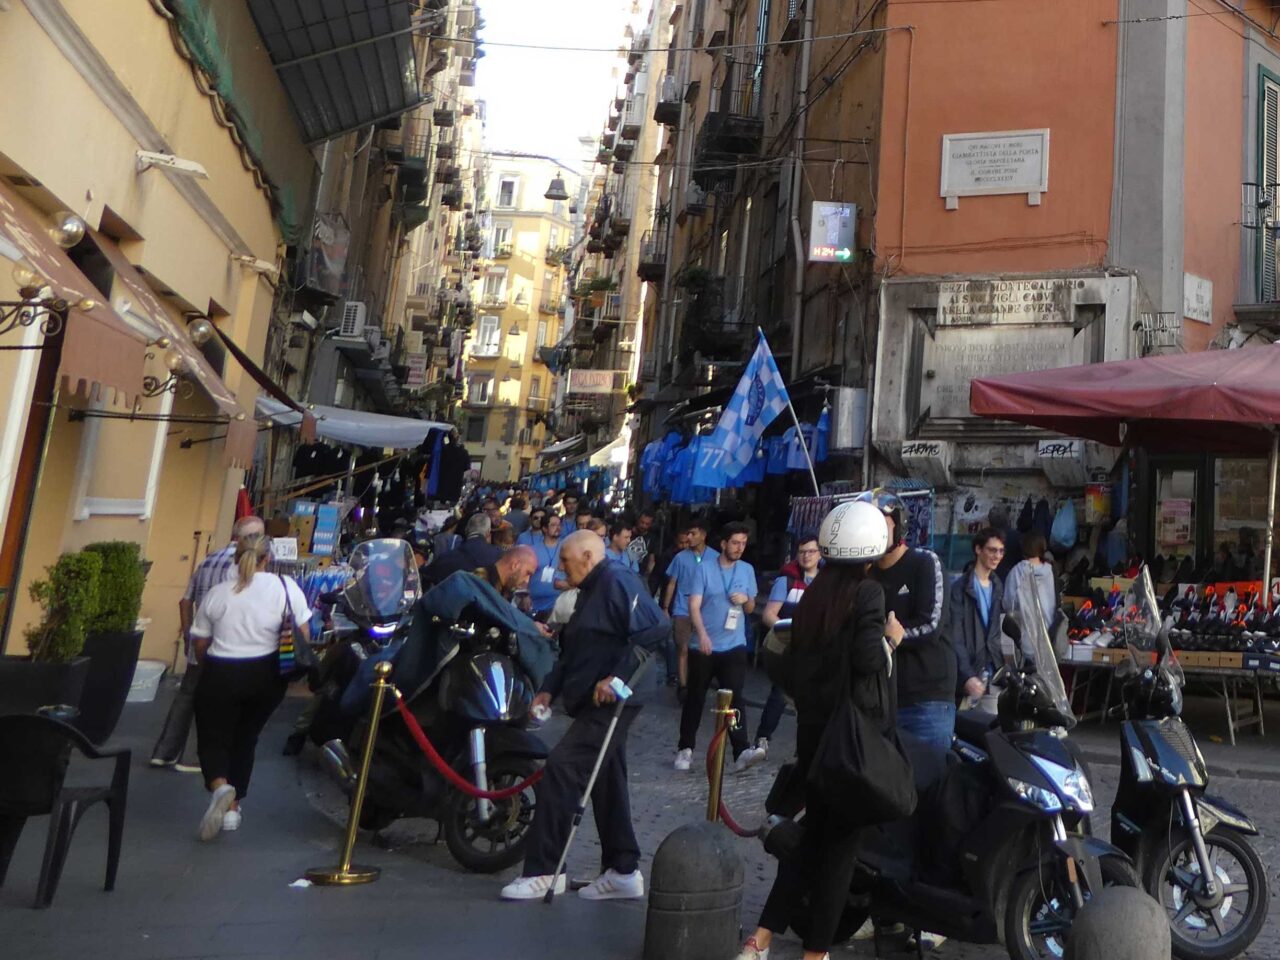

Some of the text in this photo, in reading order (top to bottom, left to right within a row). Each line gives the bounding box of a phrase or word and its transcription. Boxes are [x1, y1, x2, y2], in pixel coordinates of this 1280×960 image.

[942, 283, 988, 293] SEZIONE
[990, 280, 1086, 292] MONTECALVARIO
[943, 304, 975, 315] NELLA
[978, 303, 1021, 314] GRANDE
[700, 447, 725, 469] 77
[829, 545, 881, 557] DESIGN
